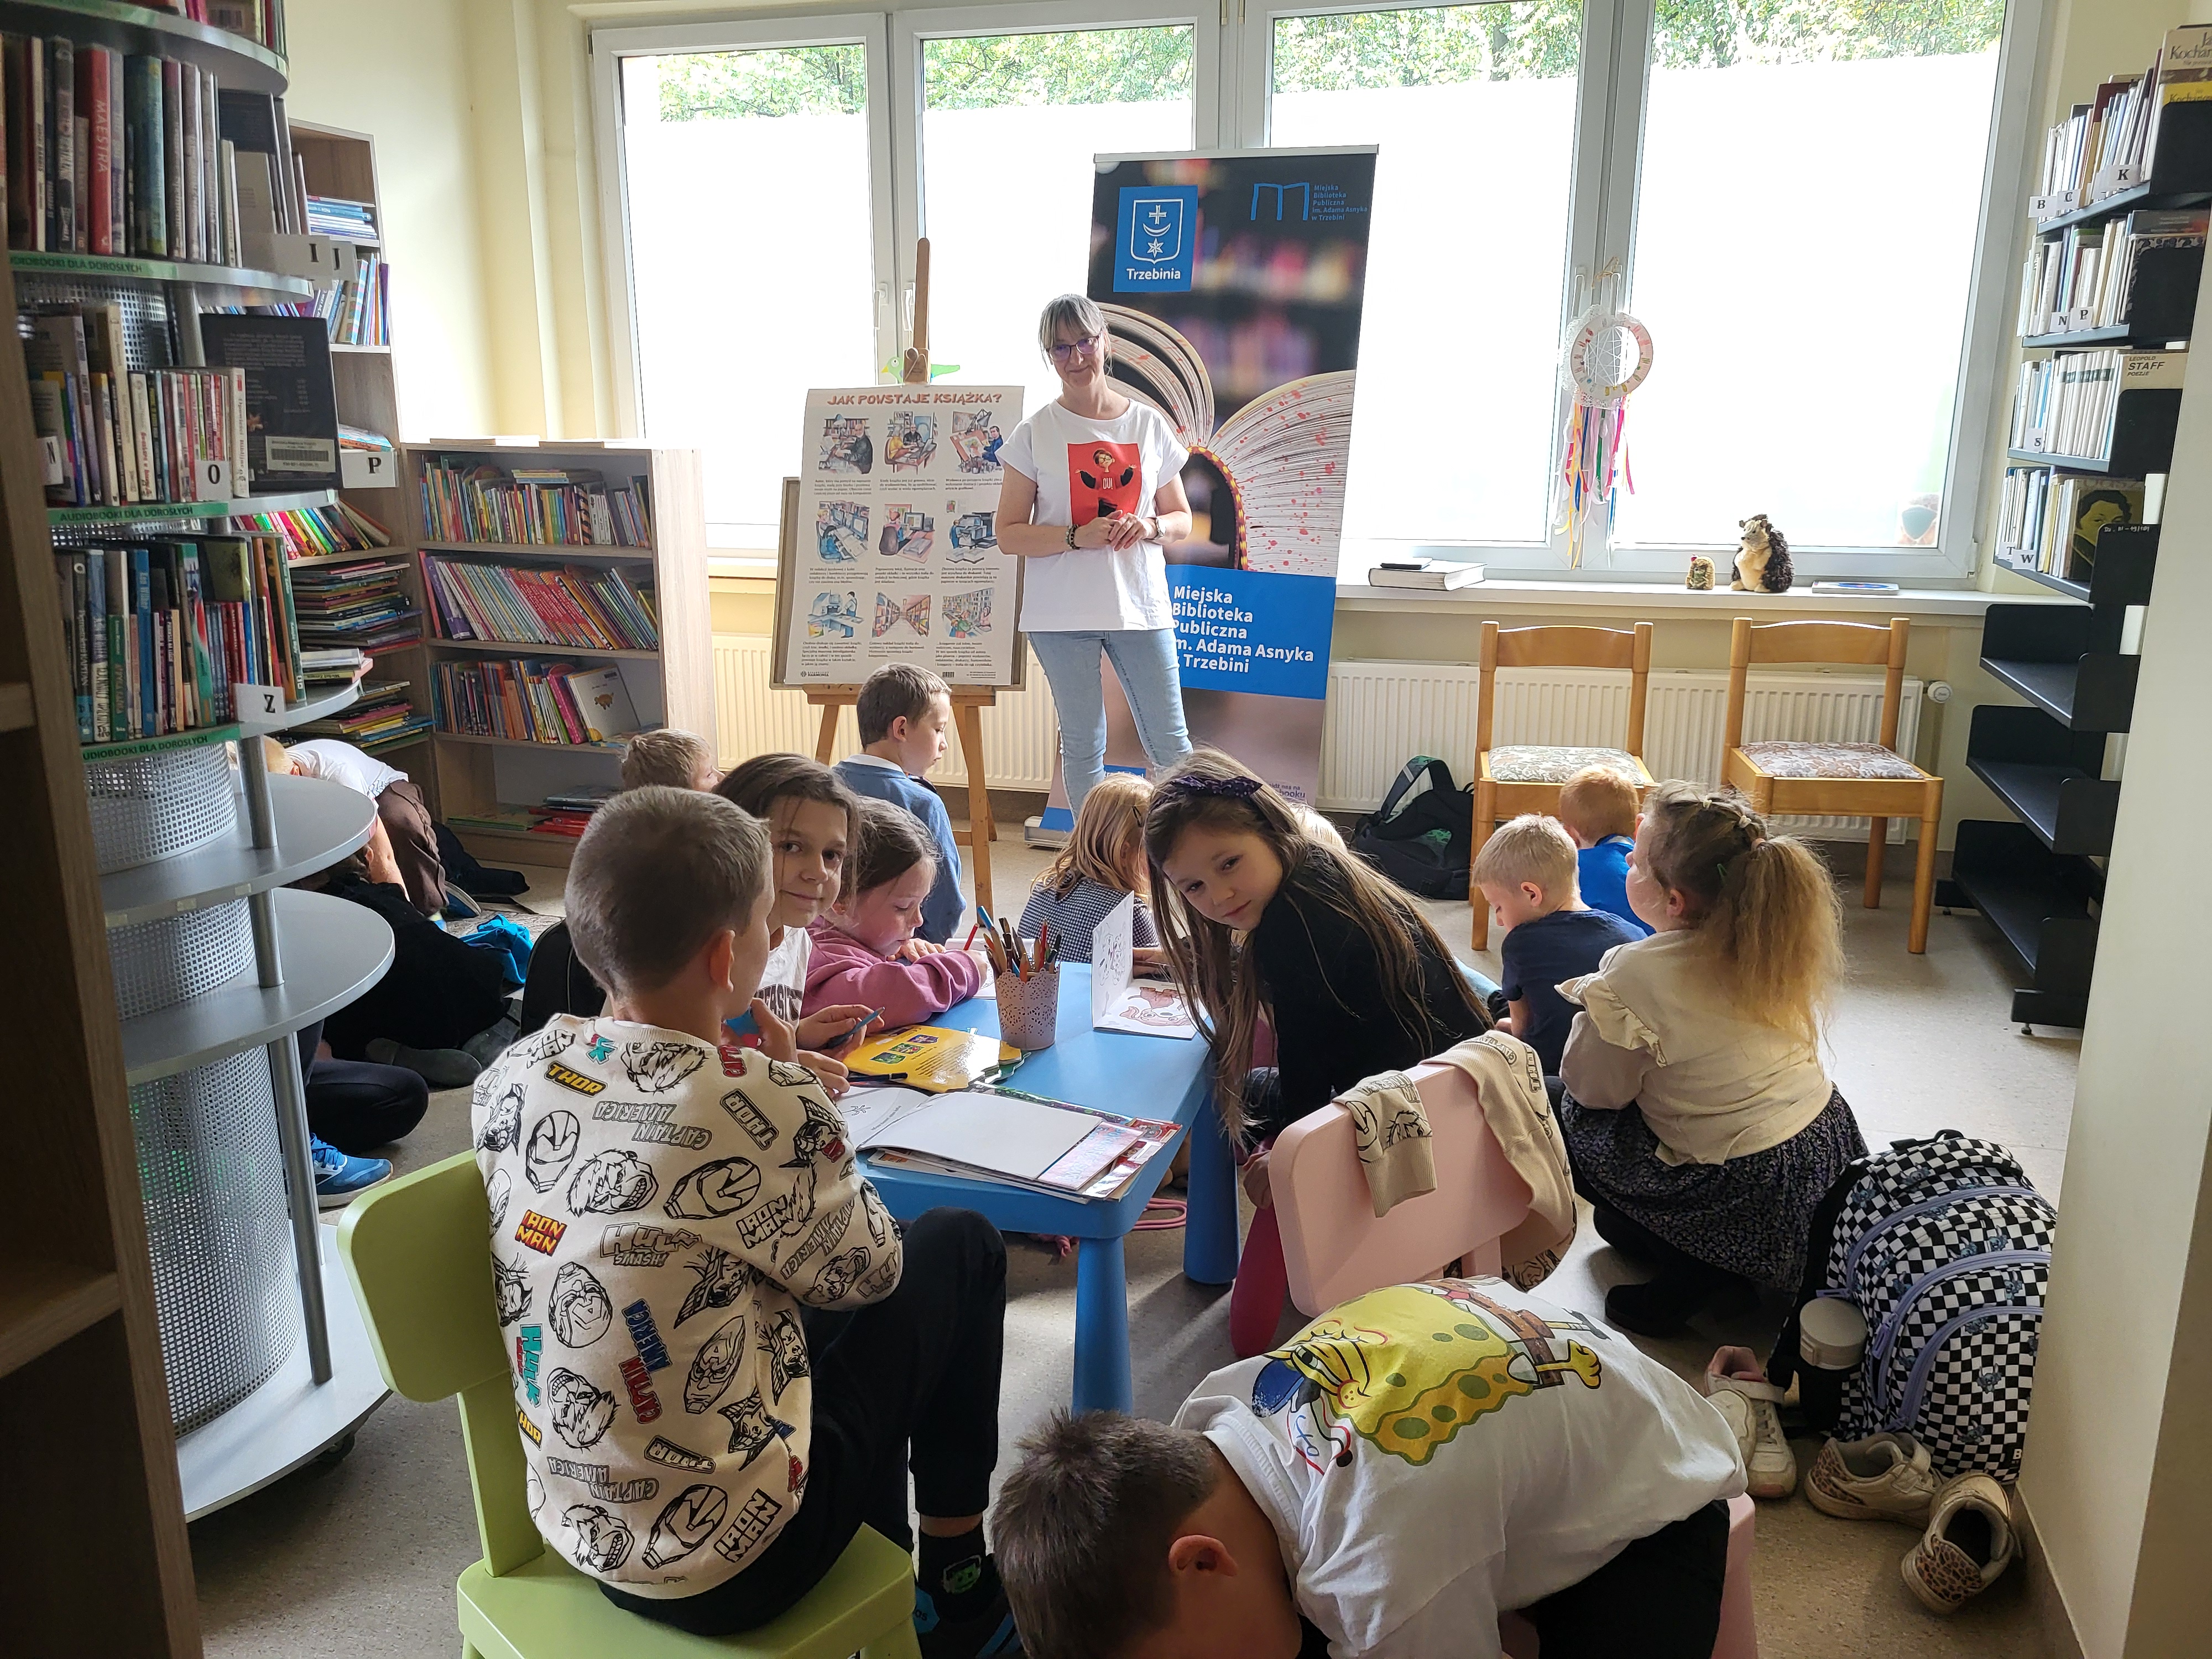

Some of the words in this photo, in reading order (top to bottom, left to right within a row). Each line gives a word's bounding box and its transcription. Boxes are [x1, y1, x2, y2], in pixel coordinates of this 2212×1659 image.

[96, 100, 107, 174] MAESTRA
[2117, 169, 2130, 181] K
[2037, 200, 2046, 210] B
[2065, 192, 2073, 202] C
[68, 260, 86, 268] DLA
[1126, 268, 1181, 281] Trzebinia
[2058, 316, 2068, 326] N
[2080, 310, 2089, 320] P
[2127, 361, 2165, 371] STAFF
[827, 395, 855, 405] JAK
[857, 393, 931, 405] POWSTAJE
[933, 392, 1003, 405] KSIĄŻKA?
[2034, 437, 2042, 447] S
[208, 465, 221, 484] O
[368, 457, 382, 474] P
[59, 511, 122, 521] AUDIOBOOKI
[124, 509, 143, 519] DLA
[144, 507, 194, 518] DOROSŁYCH
[2006, 546, 2015, 556] T
[2021, 554, 2034, 564] W
[1174, 586, 1232, 604] Miejska
[1172, 602, 1253, 623] Biblioteka
[1174, 619, 1247, 639] Publiczna
[1176, 639, 1192, 651] m.
[1196, 638, 1251, 656] Adama
[1255, 644, 1314, 663] Asnyka
[1183, 654, 1249, 673] Trzebini
[264, 693, 276, 714] Z
[83, 747, 137, 761] UDIOBOOKI
[139, 743, 157, 753] DLA
[546, 1062, 605, 1094] THOR
[1526, 1044, 1542, 1093] THO
[592, 1101, 677, 1123] AMERICA
[722, 1092, 777, 1149] THOR
[632, 1122, 712, 1151] CAPTAIN
[521, 1209, 568, 1240] IRON
[736, 1194, 788, 1235] IRON
[742, 1208, 793, 1249] MAN
[515, 1225, 557, 1256] MAN
[613, 1251, 670, 1267] SMASH!
[621, 1298, 674, 1374] AMERICA
[519, 1322, 545, 1408] HULK
[618, 1355, 663, 1425] CAPTAIN
[518, 1410, 542, 1449] HOR
[646, 1438, 715, 1472] THOR
[546, 1456, 609, 1484] AMERICA
[588, 1477, 660, 1504] CAPTAIN
[713, 1488, 770, 1558] IRON
[724, 1498, 783, 1563] MAN
